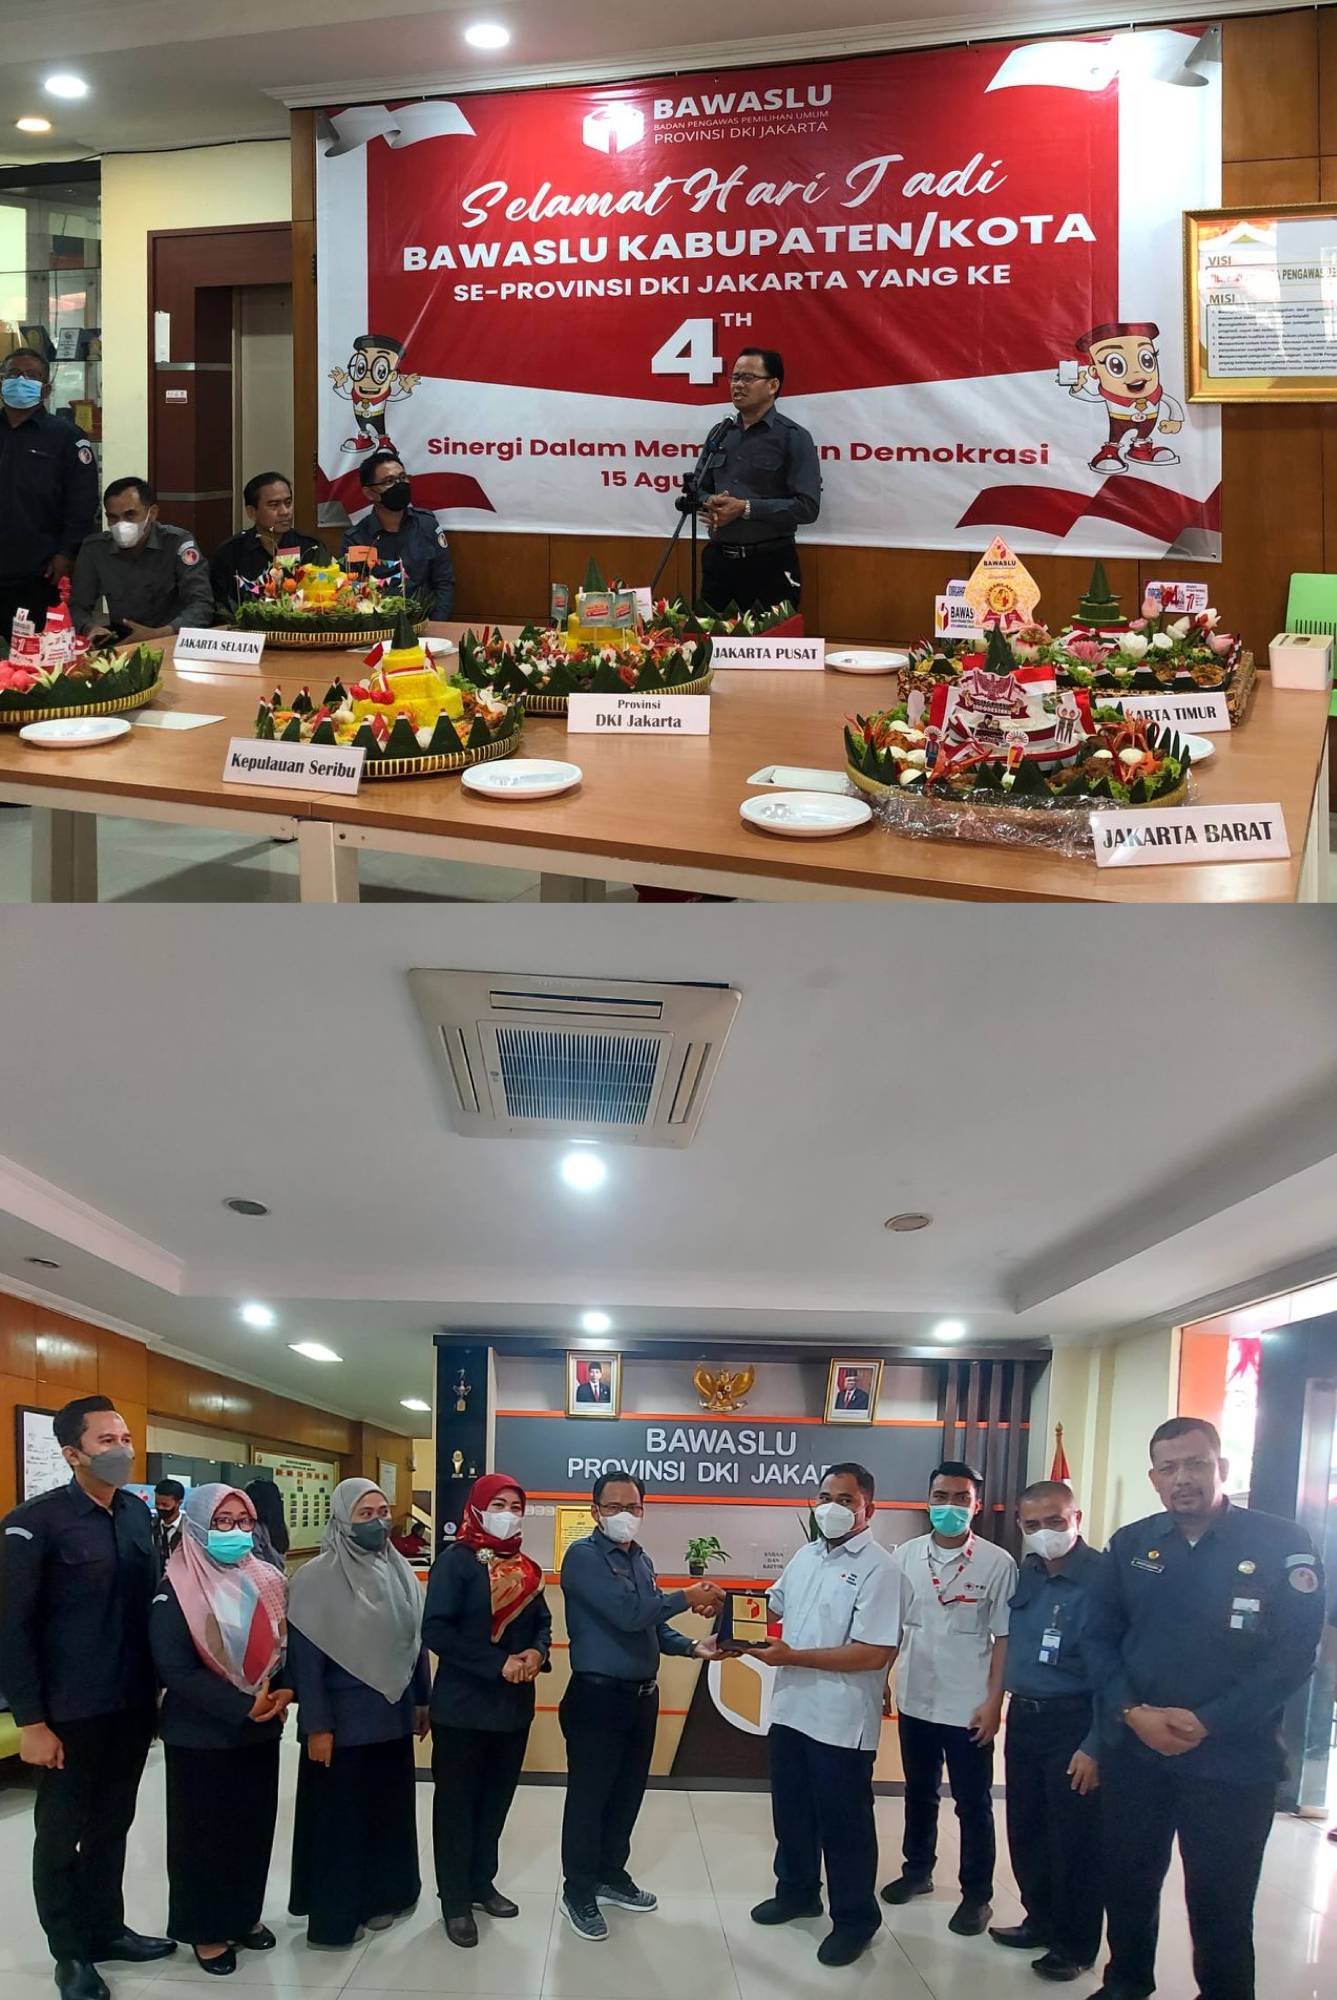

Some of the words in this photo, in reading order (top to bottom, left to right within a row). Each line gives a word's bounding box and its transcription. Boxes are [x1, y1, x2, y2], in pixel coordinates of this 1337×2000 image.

[654, 85, 832, 119] BAWASLU
[654, 122, 685, 131] BADAN
[688, 118, 739, 128] PENGAWAS
[741, 113, 793, 124] PEMILIHAN
[796, 111, 829, 120] UMUM
[654, 129, 725, 144] PROVINSI
[730, 127, 756, 139] DKI
[759, 121, 828, 139] JAKARTA
[461, 176, 688, 229] Selamat
[682, 165, 827, 214] Hari
[403, 236, 608, 272] BAWASLU
[618, 211, 1096, 263] KABUPATEN/KOTA
[1208, 256, 1231, 266] VISI
[454, 277, 632, 301] SE-PROVINSI
[639, 276, 689, 296] DKI
[698, 270, 848, 294] JAKARTA
[857, 266, 958, 289] YANG
[968, 264, 1011, 285] KE
[1209, 294, 1235, 304] MISI
[651, 317, 723, 384] 4
[428, 437, 523, 461] Sinergi
[530, 439, 626, 457] Dalam
[850, 442, 1048, 465] Demokrasi
[601, 471, 627, 487] 15
[951, 607, 973, 619] BAWAS
[179, 638, 217, 650] JAKARTA
[220, 641, 259, 653] SELATAN
[713, 647, 772, 660] JAKARTA
[776, 647, 818, 660] PUSAT
[617, 699, 661, 710] Provinsi
[1132, 708, 1171, 721] ARTA
[1173, 706, 1217, 720] TIMUR
[596, 714, 622, 727] DKI
[627, 714, 681, 728] Jakarta
[231, 753, 305, 773] Kepulauan
[308, 760, 356, 778] Seribu
[1103, 825, 1198, 849] JAKARTA
[1204, 821, 1272, 843] BARAT
[646, 1428, 796, 1456] BAWASLU
[568, 1458, 685, 1481] PROVINSI
[698, 1462, 739, 1483] DKI
[750, 1463, 831, 1484] JAKA
